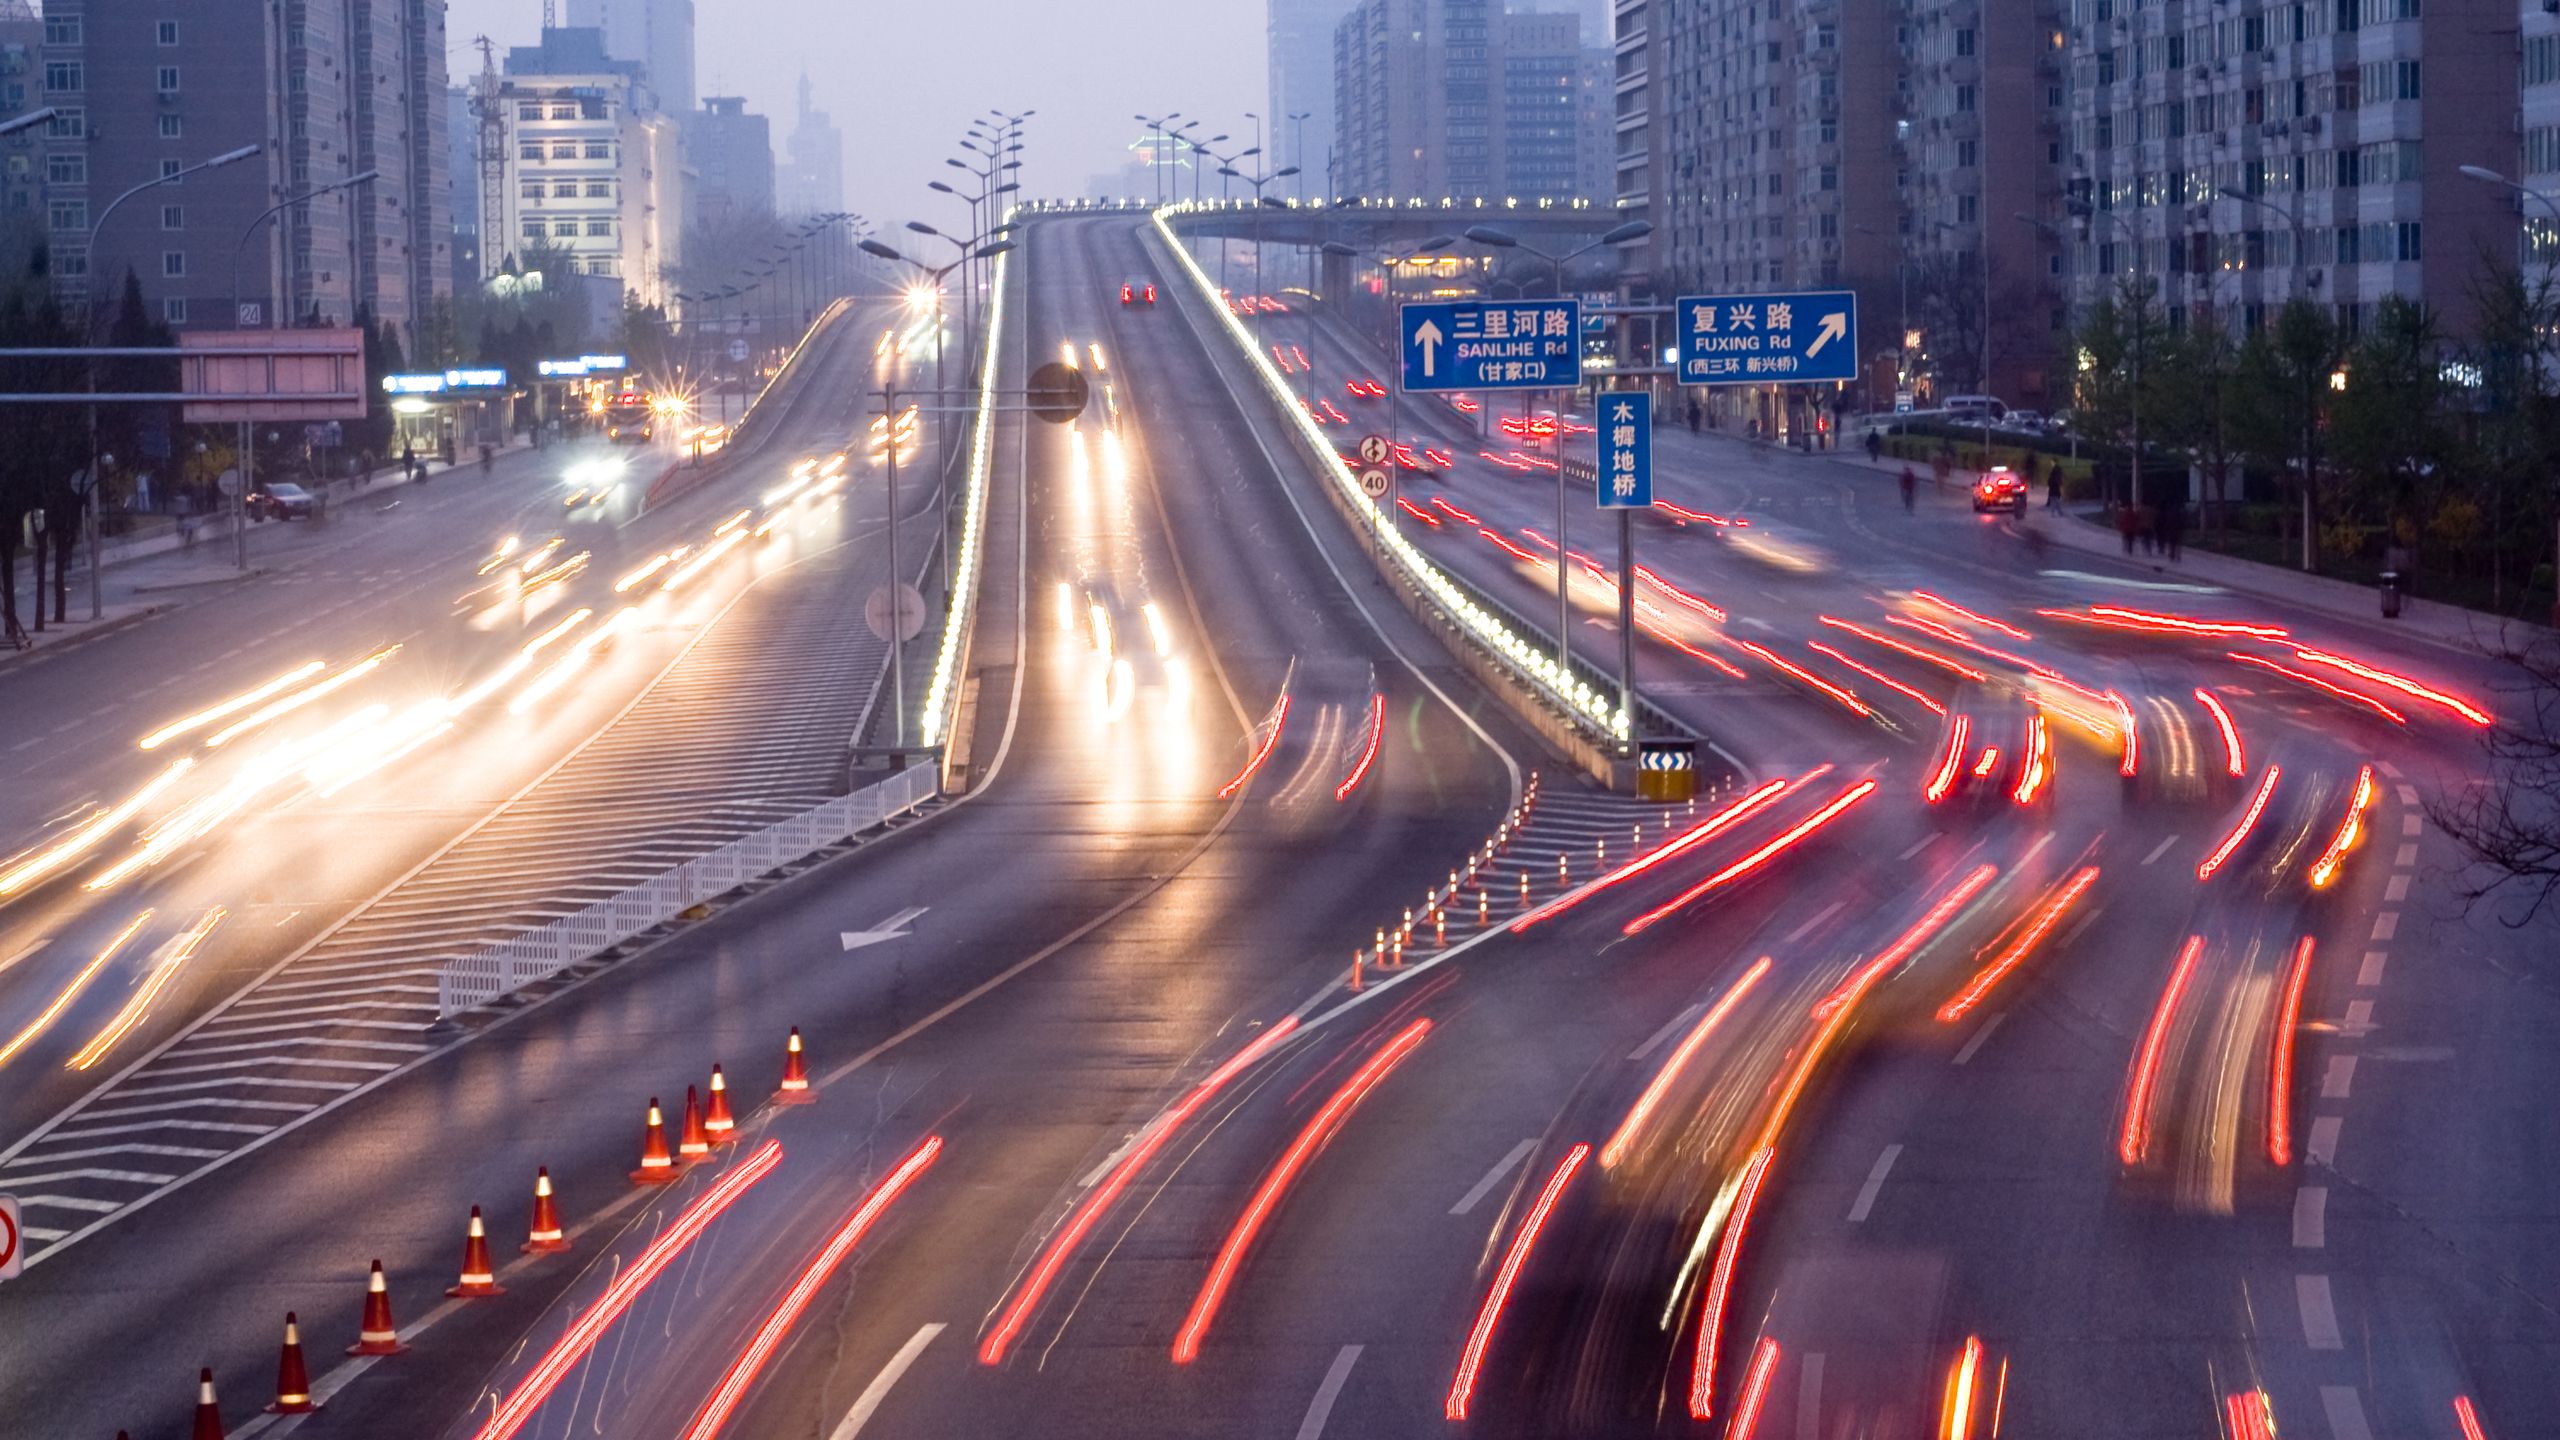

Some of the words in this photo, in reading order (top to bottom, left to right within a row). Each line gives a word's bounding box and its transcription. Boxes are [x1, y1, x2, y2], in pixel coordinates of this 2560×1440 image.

[1452, 308, 1570, 339] 三里河路
[1691, 302, 1793, 334] 复兴路
[1457, 342, 1535, 358] SANLIHE
[1544, 341, 1567, 356] Rd
[1695, 336, 1760, 352] FUXING
[1769, 335, 1791, 349] Rd
[1478, 361, 1546, 382] (甘家口)
[1365, 476, 1384, 490] 40
